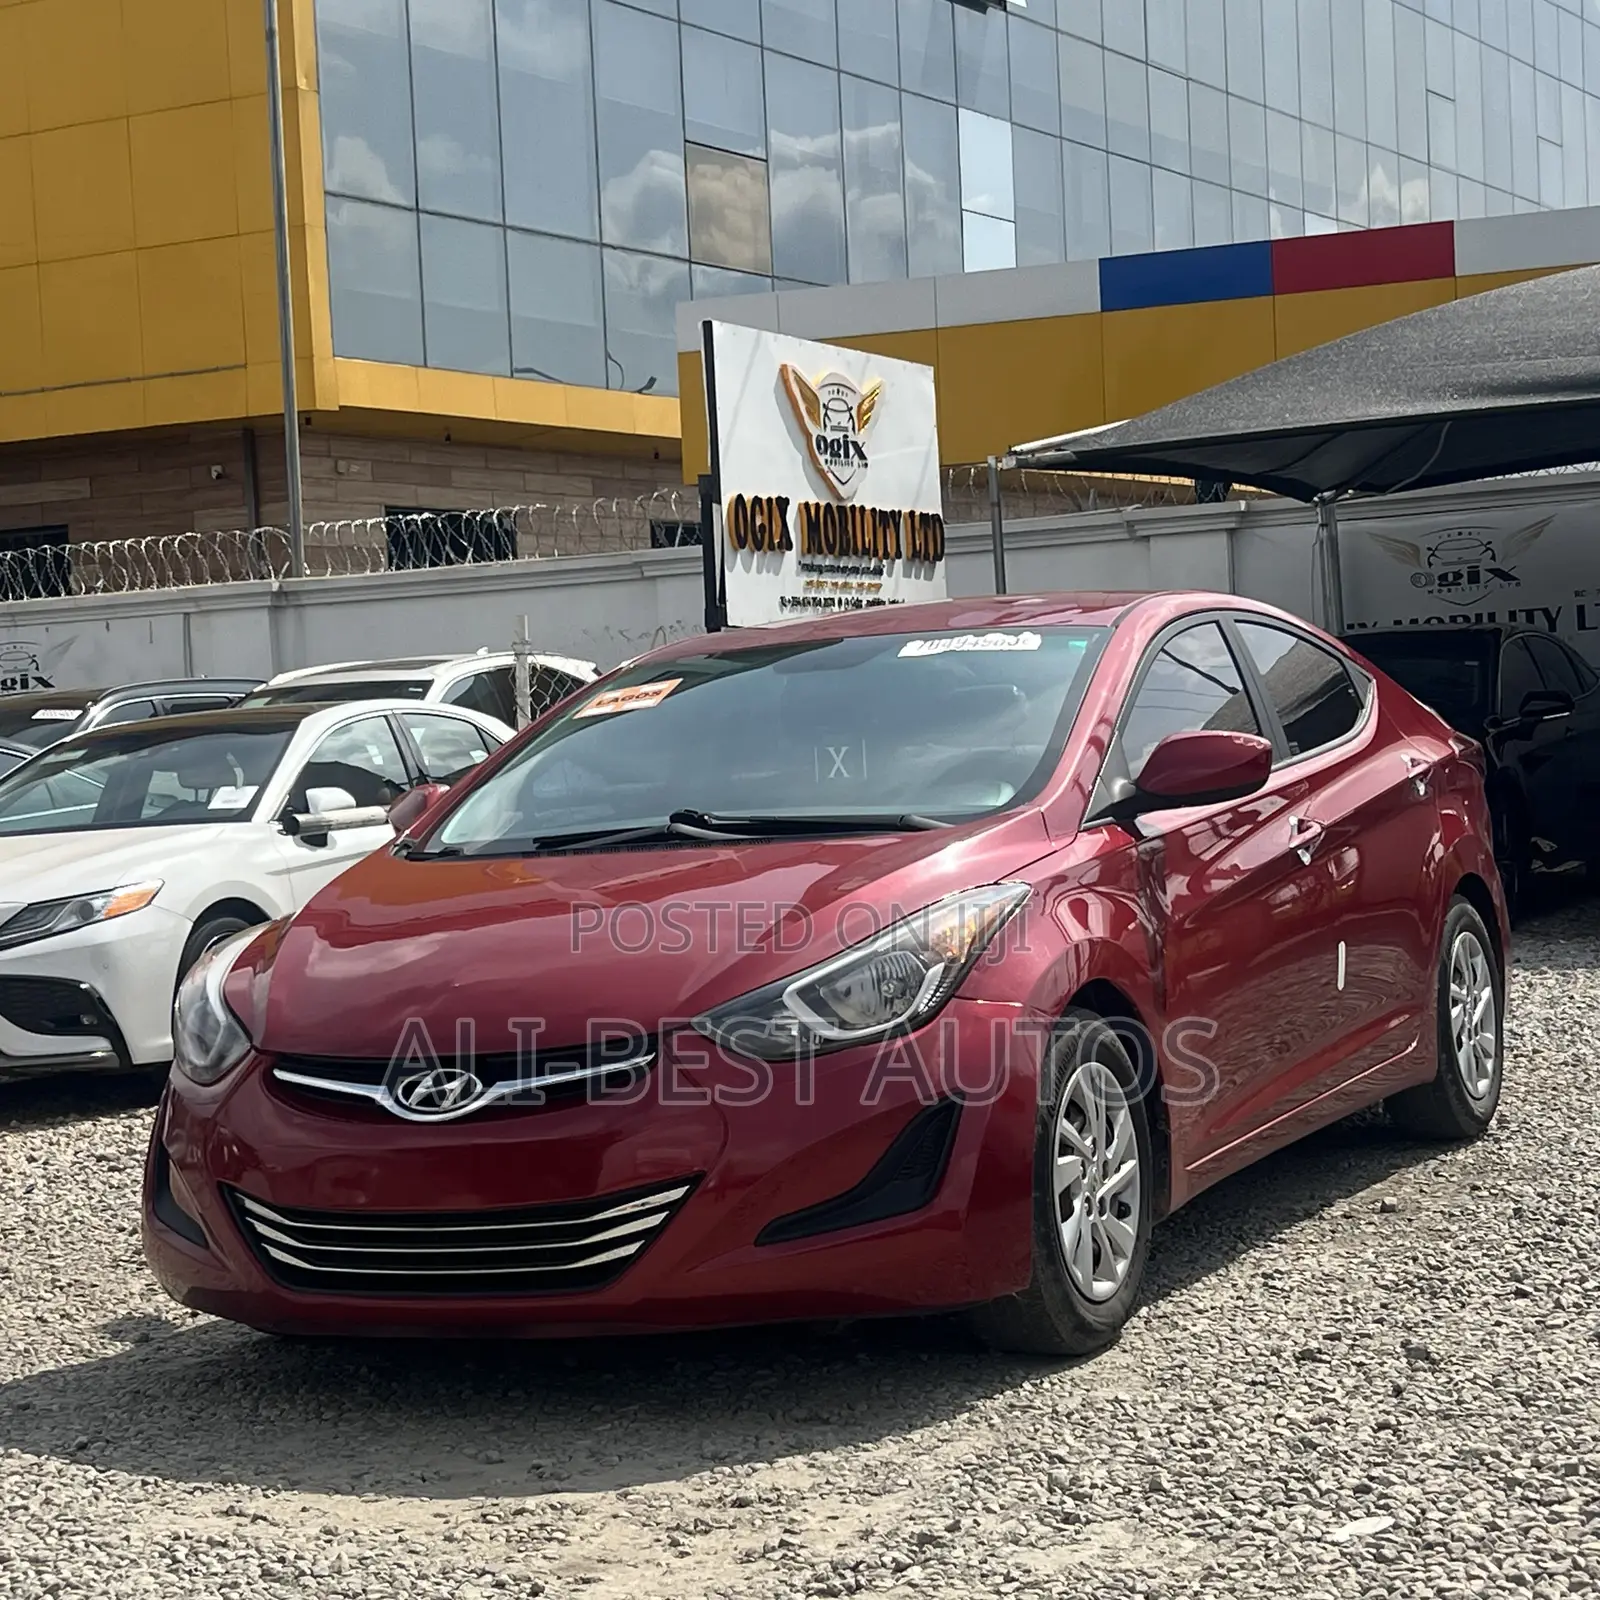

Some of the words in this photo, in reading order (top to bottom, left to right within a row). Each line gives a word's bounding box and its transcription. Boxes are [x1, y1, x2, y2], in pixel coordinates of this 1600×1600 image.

[731, 493, 793, 552] OGIX
[800, 501, 903, 561] MOBILITY
[905, 509, 945, 562] LTD
